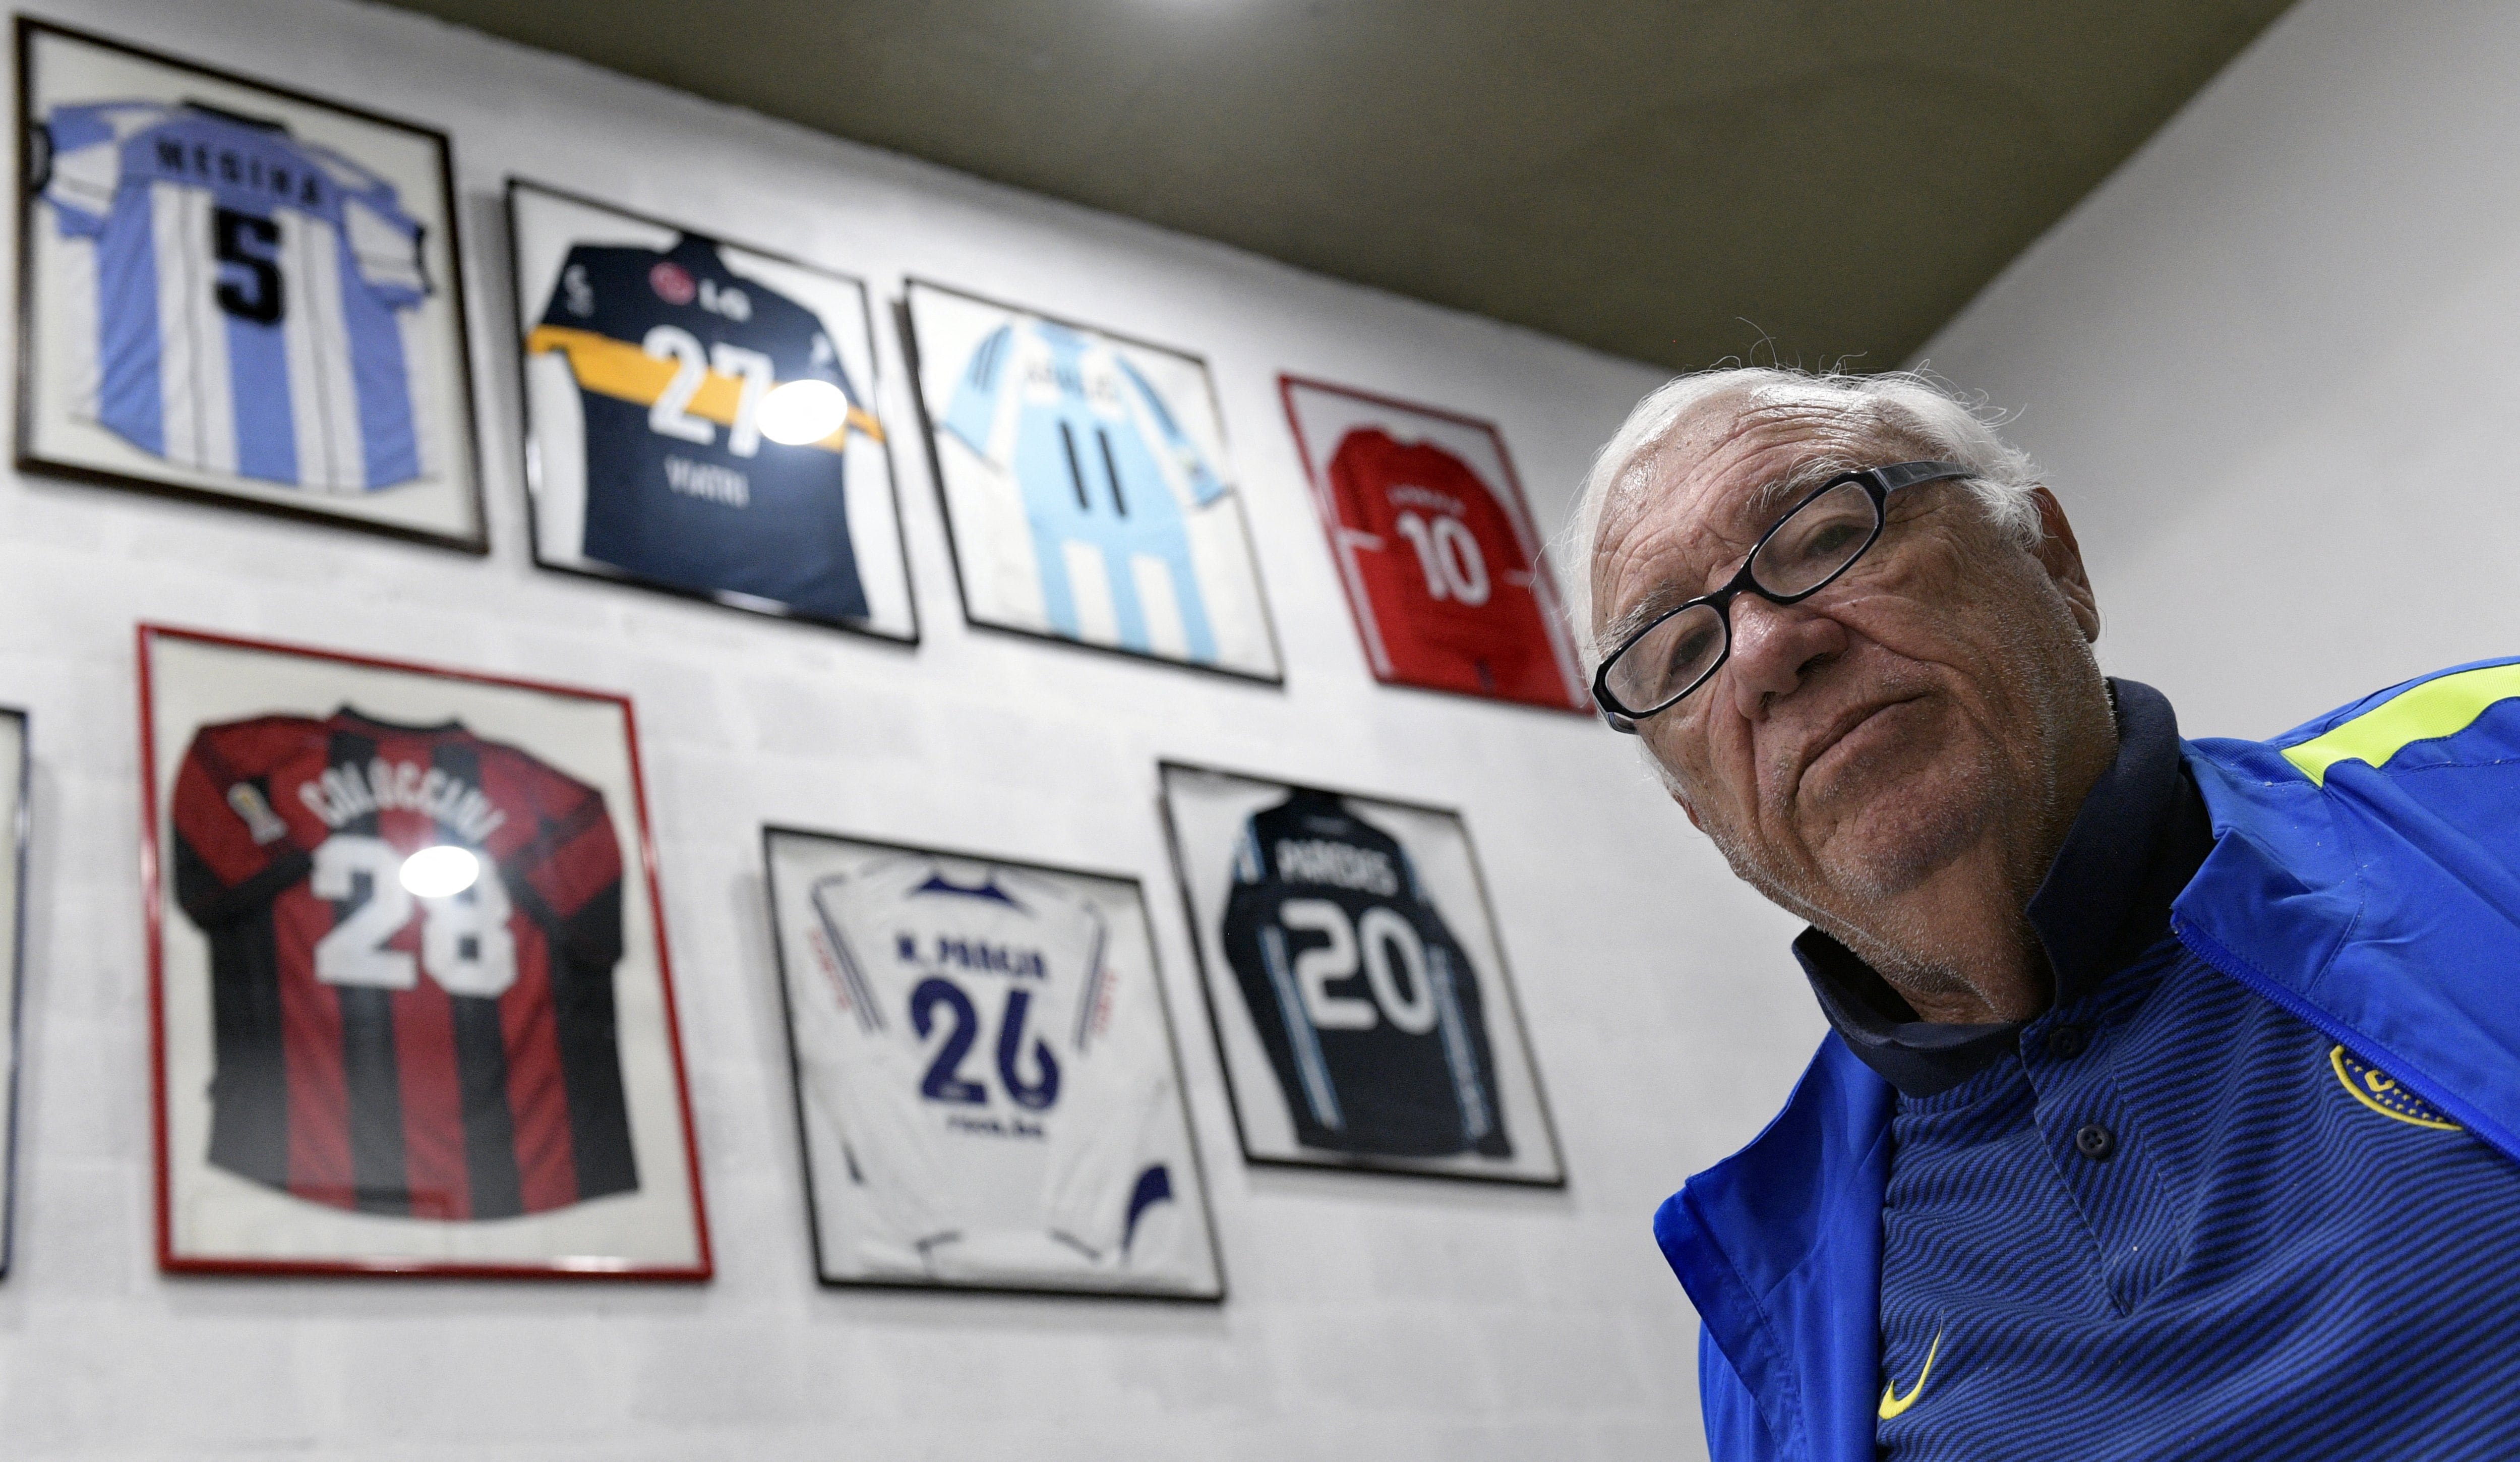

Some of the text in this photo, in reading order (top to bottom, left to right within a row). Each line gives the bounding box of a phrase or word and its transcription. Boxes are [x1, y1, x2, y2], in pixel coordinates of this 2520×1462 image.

[213, 205, 287, 332] 5
[643, 325, 774, 457] 27
[1058, 419, 1129, 520] 11
[1396, 512, 1491, 607] 10
[310, 835, 518, 999] 28
[1279, 899, 1439, 1035] 20
[910, 975, 1061, 1113] 26
